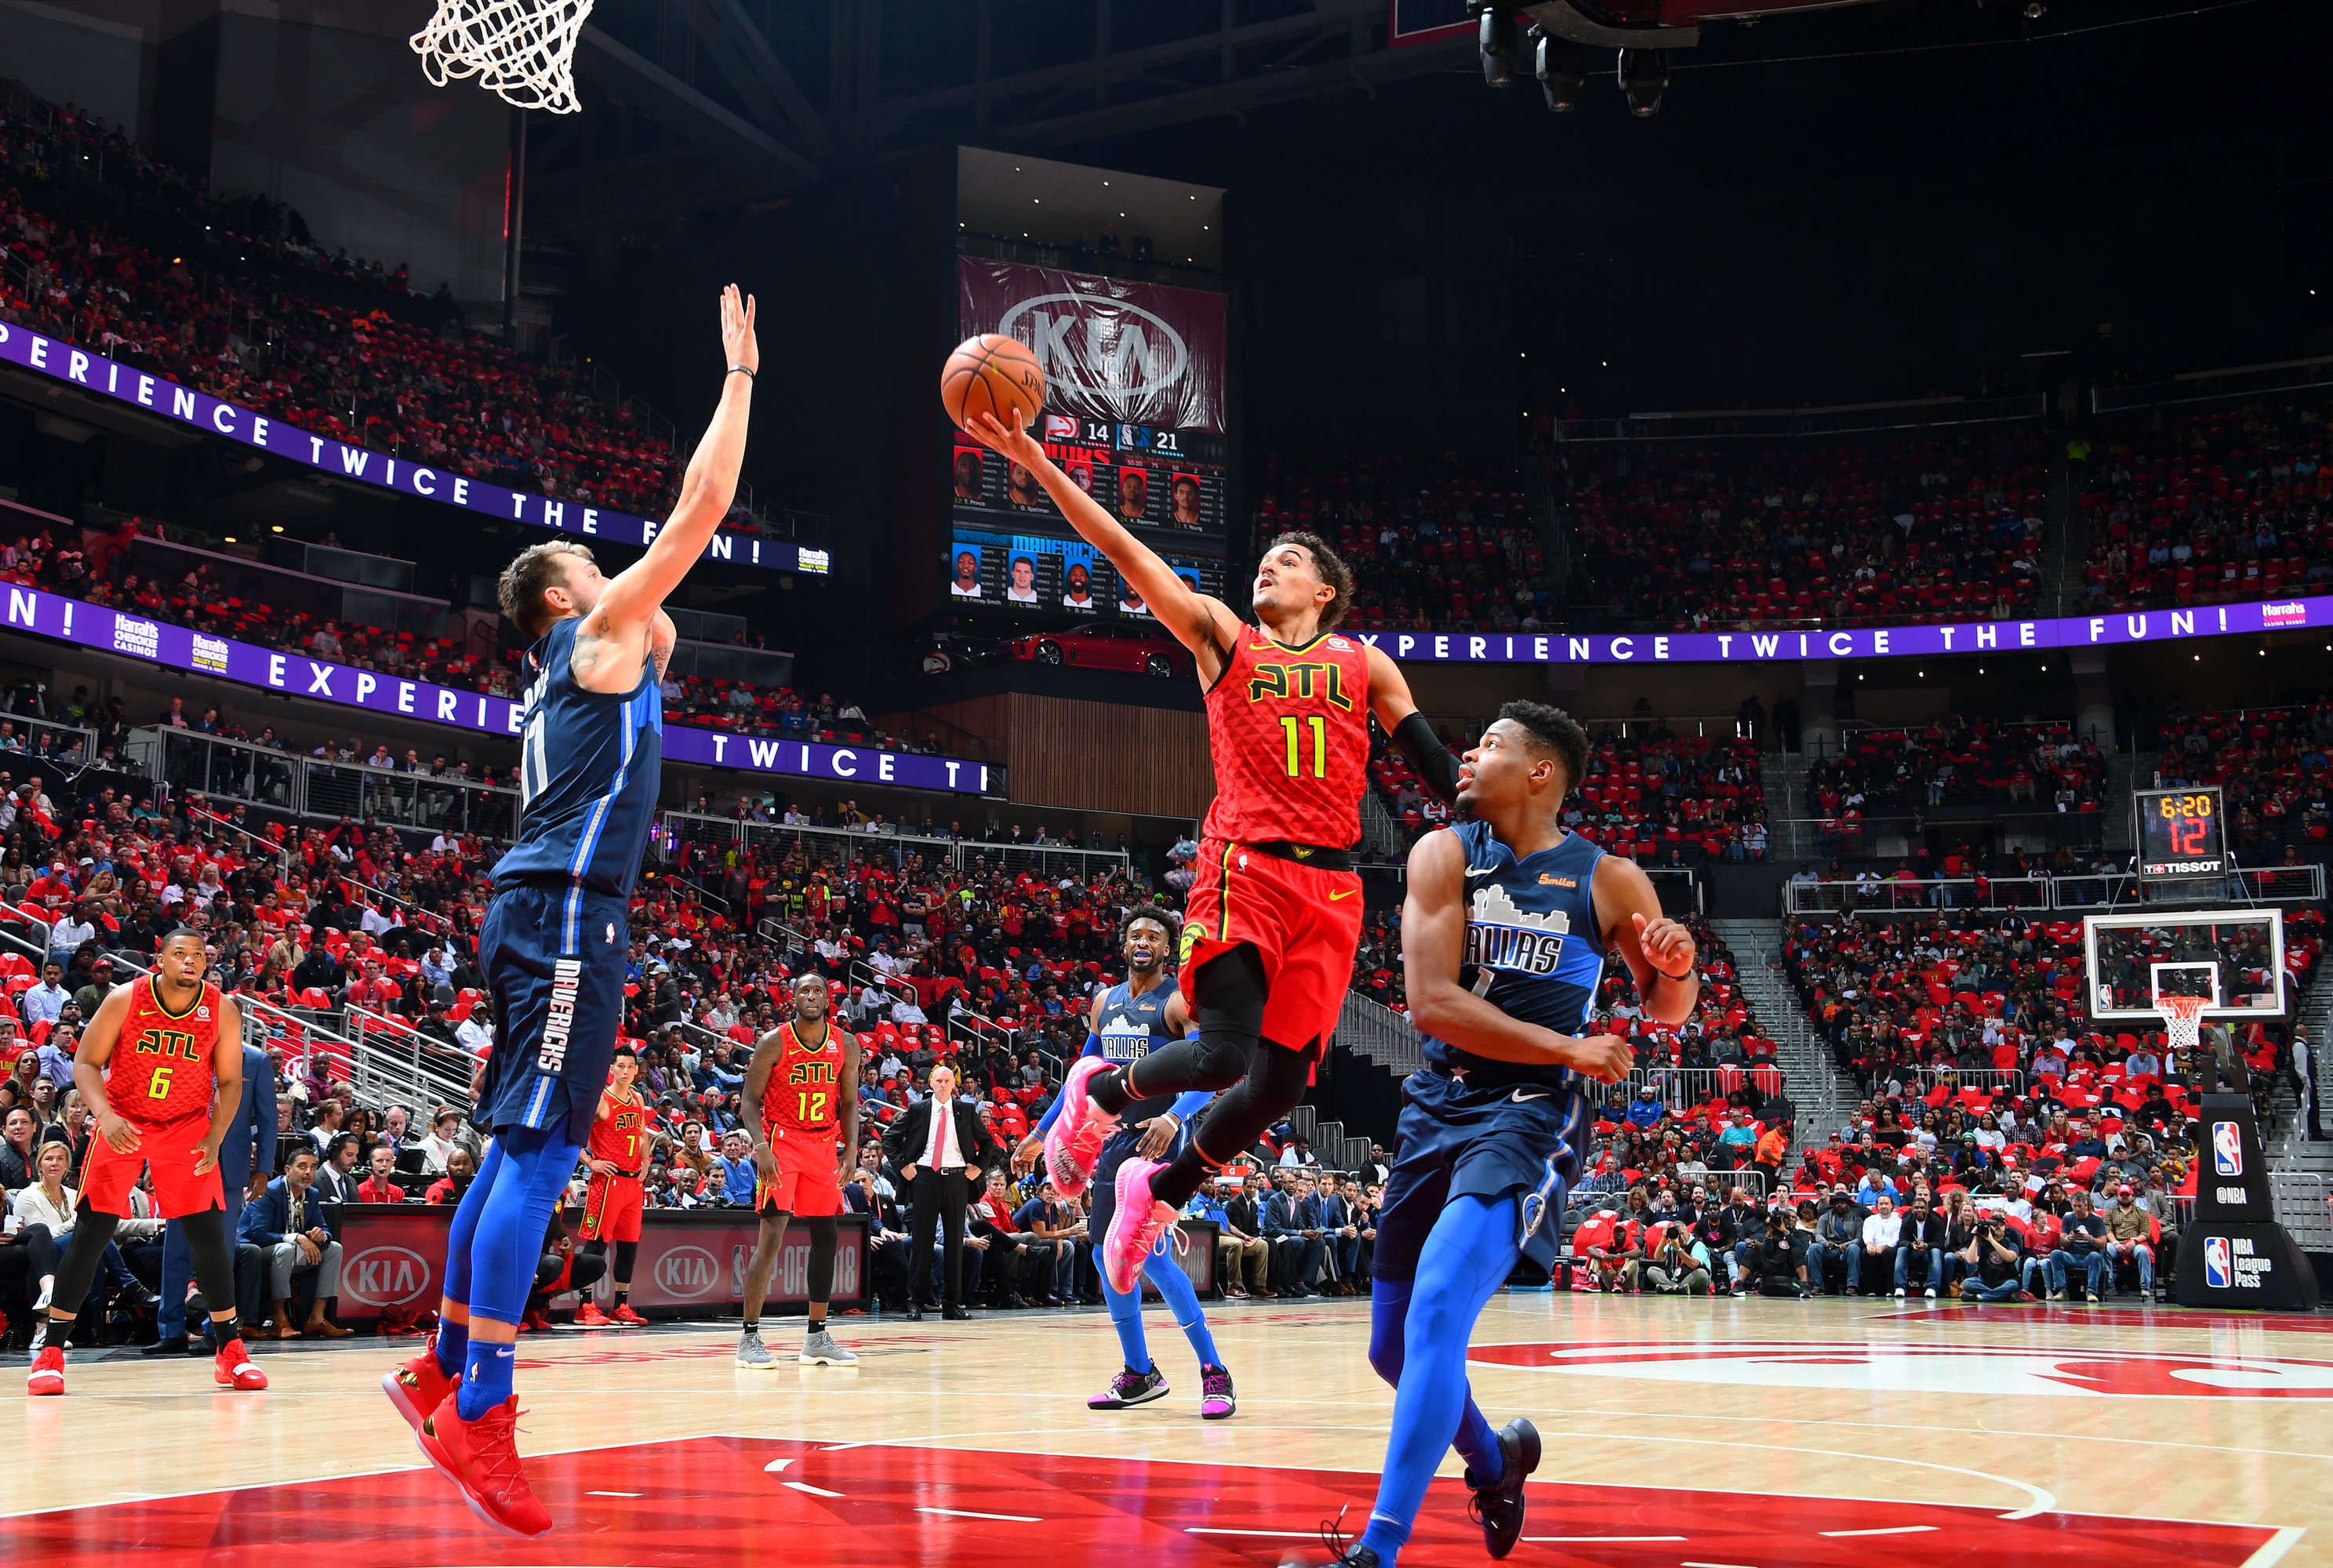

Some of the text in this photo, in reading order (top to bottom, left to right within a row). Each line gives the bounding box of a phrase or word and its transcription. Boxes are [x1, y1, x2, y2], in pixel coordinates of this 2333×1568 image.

[1033, 311, 1154, 377] KIA
[1088, 423, 1178, 450] 14 21
[310, 436, 469, 505] TWICE
[512, 493, 598, 535] THE
[642, 521, 760, 564] FN!
[8, 588, 72, 637] N!
[115, 614, 159, 639] Harrah's
[114, 630, 158, 649] CHEROKEE
[1357, 608, 2227, 660] XPERIENCE TWICE THE FUN!
[113, 640, 158, 659] CASINOS
[1247, 662, 1353, 712] ATL
[270, 654, 525, 734] EXPERIE
[713, 734, 896, 782] TWICE
[1279, 715, 1326, 779] 11
[2160, 794, 2211, 819] 6:20
[2171, 818, 2207, 855] 12
[1538, 873, 1577, 888] 5miles
[2164, 861, 2222, 874] TISSOT
[1463, 924, 1564, 975] ALLAS
[538, 959, 582, 1073] MAVERICKS
[136, 1029, 200, 1062] ATL
[1102, 1036, 1149, 1059] DALLAS
[148, 1067, 174, 1100] 6
[788, 1062, 837, 1085] ATL
[798, 1092, 826, 1121] 12
[615, 1112, 641, 1131] ATL
[627, 1135, 636, 1157] 7
[2216, 1187, 2248, 1205] @NBA
[2232, 1238, 2255, 1255] NBA
[359, 1260, 416, 1292] KIA
[666, 1256, 710, 1285] KIA
[2233, 1255, 2272, 1275] League
[2234, 1272, 2262, 1288] Pass
